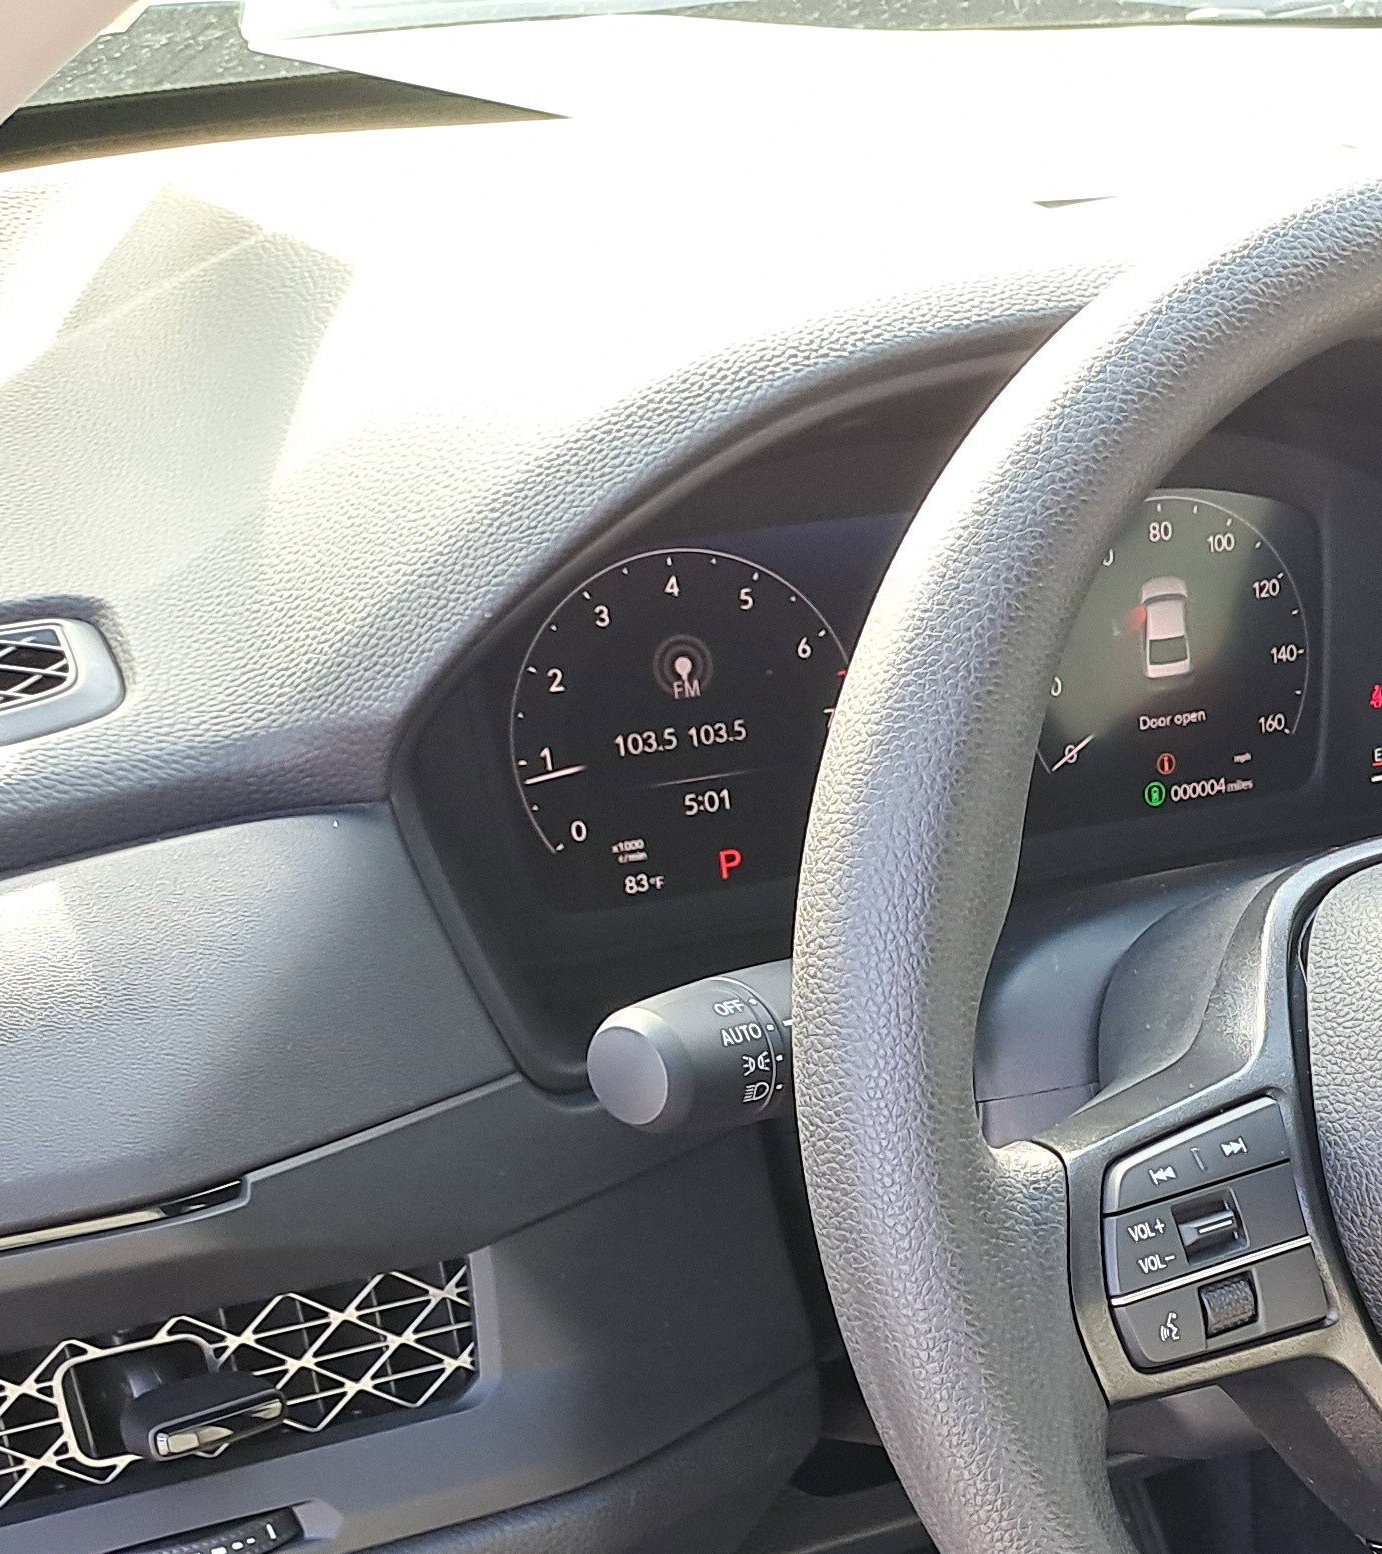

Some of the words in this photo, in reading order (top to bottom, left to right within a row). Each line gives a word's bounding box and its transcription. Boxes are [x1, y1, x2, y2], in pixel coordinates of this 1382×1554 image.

[1148, 520, 1173, 542] 80
[1207, 532, 1235, 553] 100
[663, 575, 680, 598] 4
[1252, 577, 1280, 600] 120
[739, 588, 754, 611] 5
[594, 604, 611, 628] 3
[796, 636, 812, 659] 6
[1270, 643, 1298, 664] 140
[546, 668, 566, 694] 2
[673, 680, 701, 699] FM
[1139, 714, 1173, 731] Door
[1173, 710, 1207, 727] open
[1258, 713, 1286, 735] 160
[614, 727, 678, 758] 103.5
[686, 719, 748, 749] 103.5
[540, 746, 554, 771] 1
[1170, 777, 1226, 802] 000004
[1226, 779, 1254, 792] miles
[683, 788, 731, 816] 5:01
[570, 819, 588, 842] 0
[718, 848, 743, 880] P
[713, 998, 746, 1018] OFF
[720, 1022, 763, 1047] AUTO
[1127, 1217, 1166, 1244] VOL+
